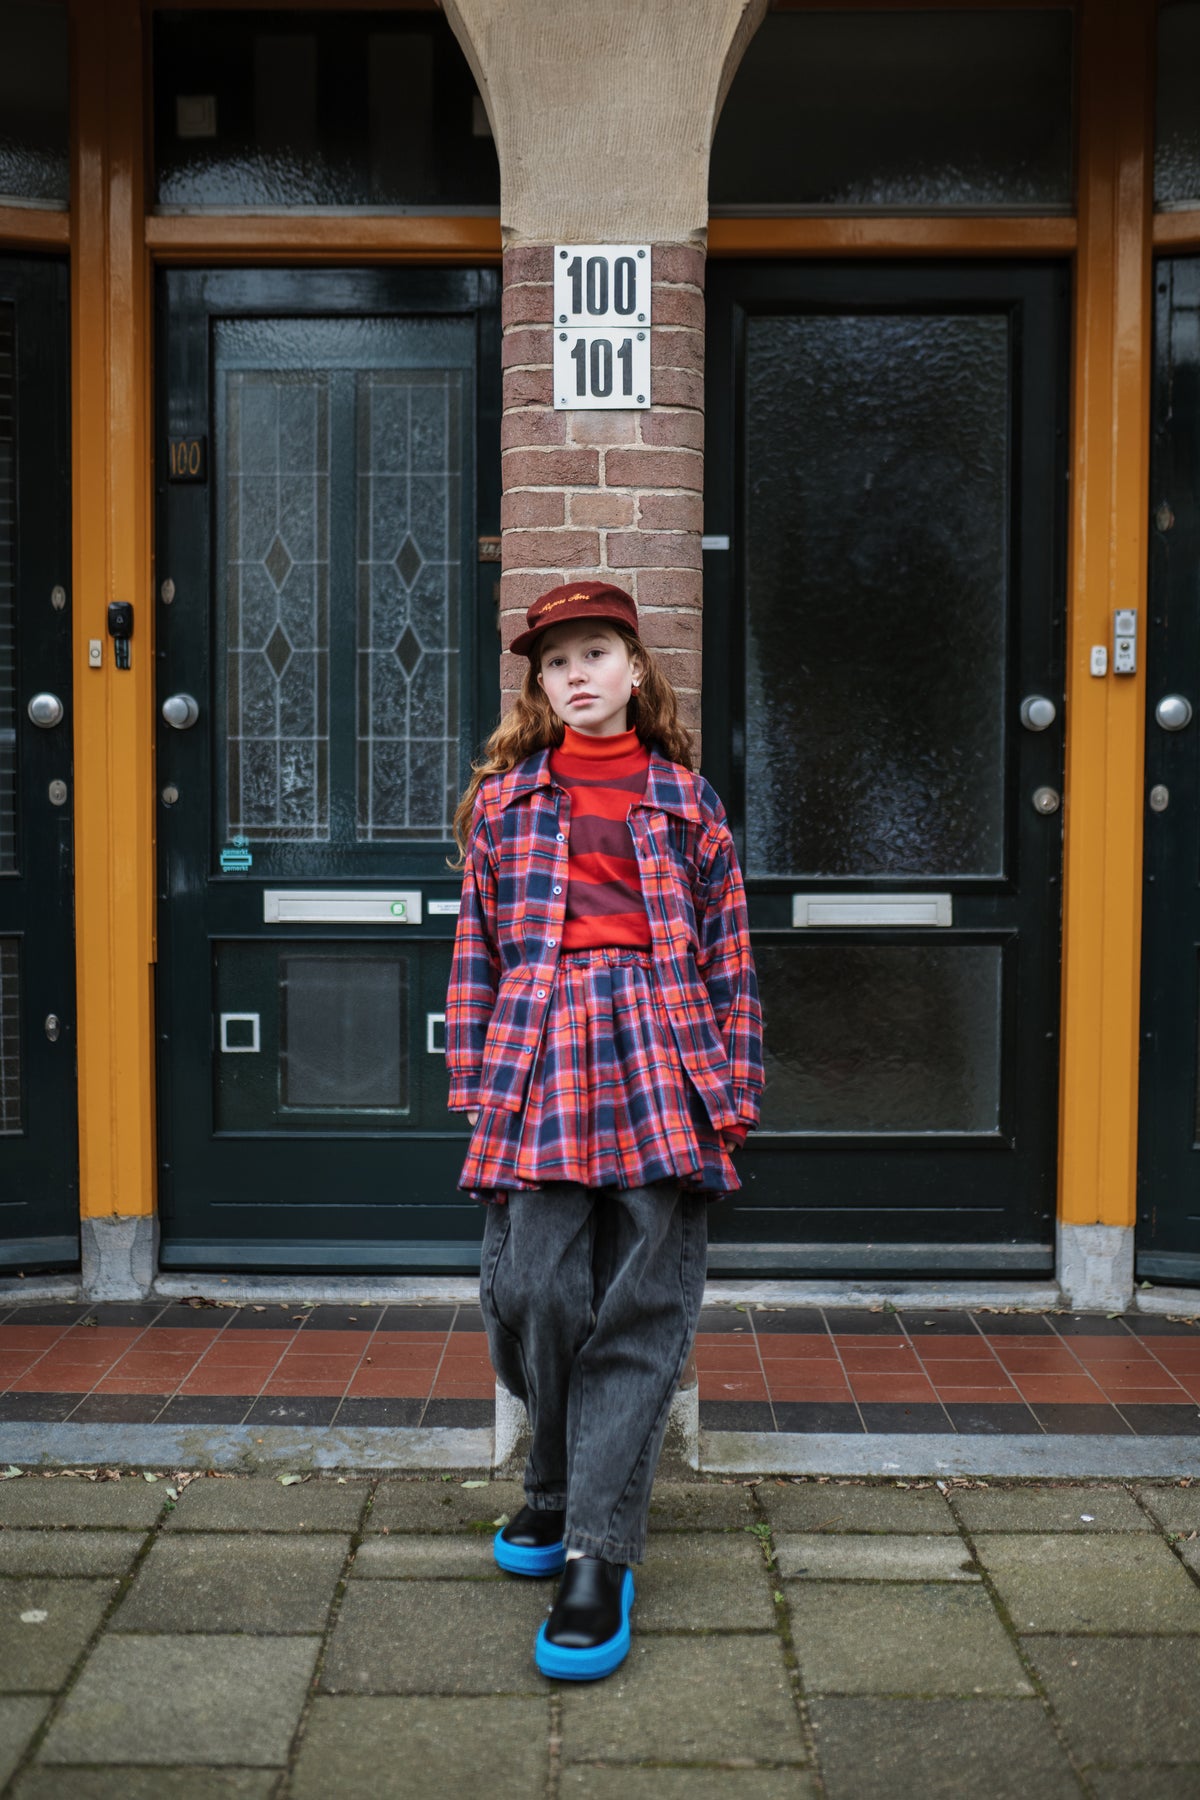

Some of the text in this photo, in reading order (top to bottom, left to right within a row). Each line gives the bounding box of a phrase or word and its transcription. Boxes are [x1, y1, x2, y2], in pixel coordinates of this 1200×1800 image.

[567, 256, 636, 316] 100
[570, 338, 633, 397] 101
[171, 441, 201, 475] 100
